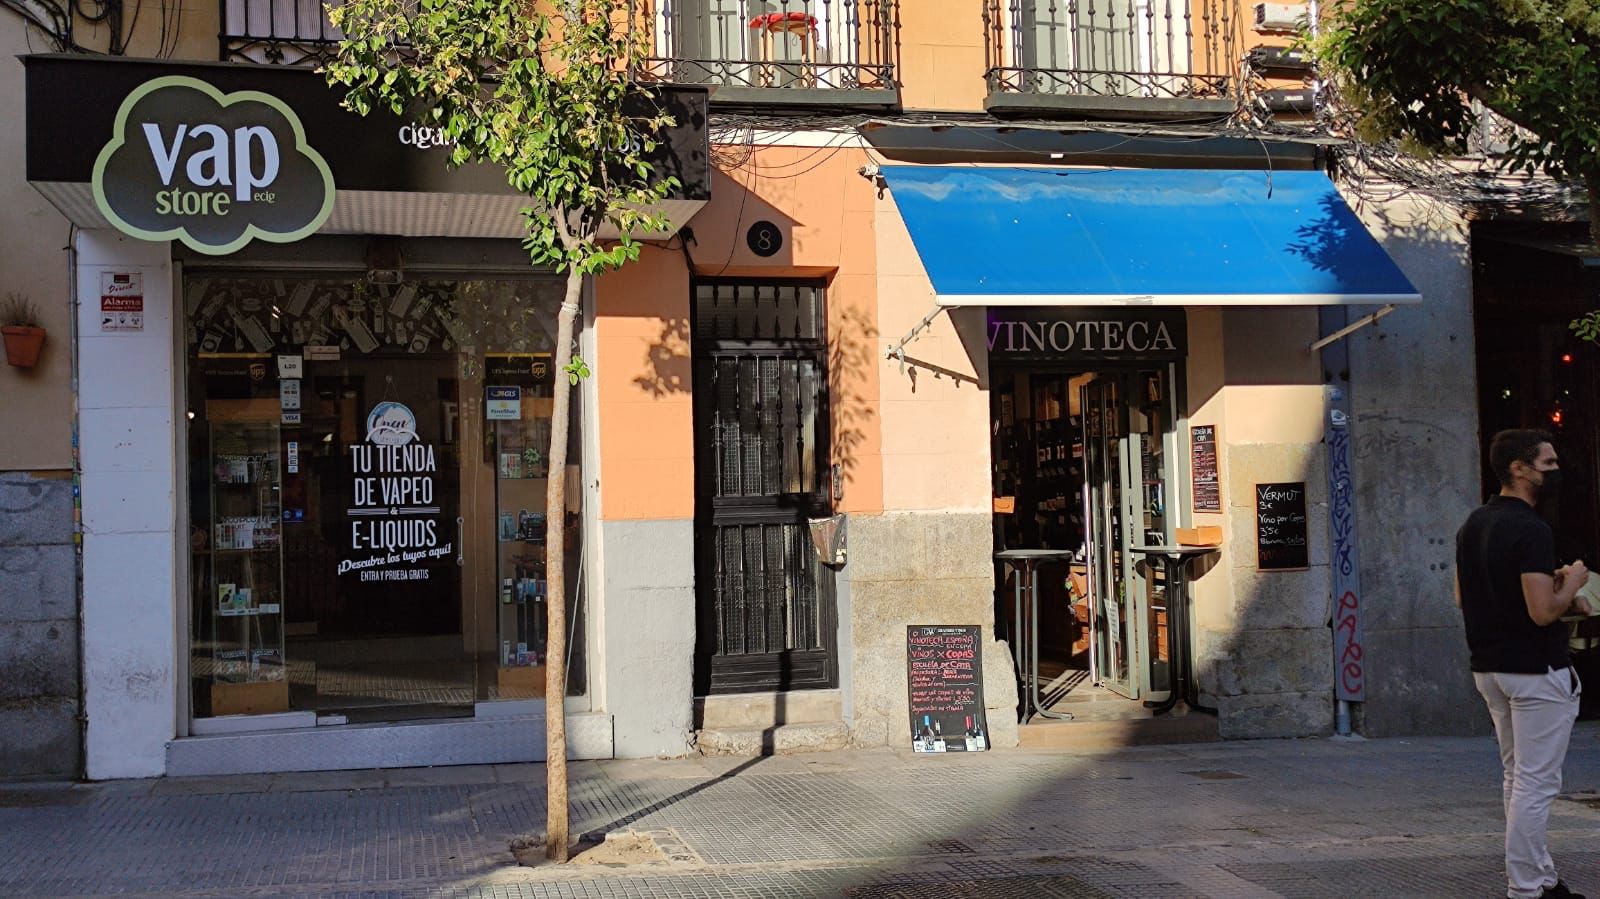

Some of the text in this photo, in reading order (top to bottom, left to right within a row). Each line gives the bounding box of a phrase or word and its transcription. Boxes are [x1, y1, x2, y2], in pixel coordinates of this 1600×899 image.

[142, 122, 280, 202] vap
[155, 187, 230, 216] store
[254, 190, 275, 204] ecig
[757, 229, 771, 250] 8
[103, 297, 142, 306] Alarma
[985, 320, 1177, 352] VINOTECA
[350, 444, 436, 473] TU TIENDA
[354, 476, 433, 506] DE VAPEO
[389, 506, 399, 516] &
[352, 519, 437, 552] E-LIQUIDS
[337, 543, 452, 576] ¡Descubre los tuyos aquí!
[360, 569, 429, 582] ENTRA Y PRUEBA GRATIS
[945, 649, 975, 659] COPAS
